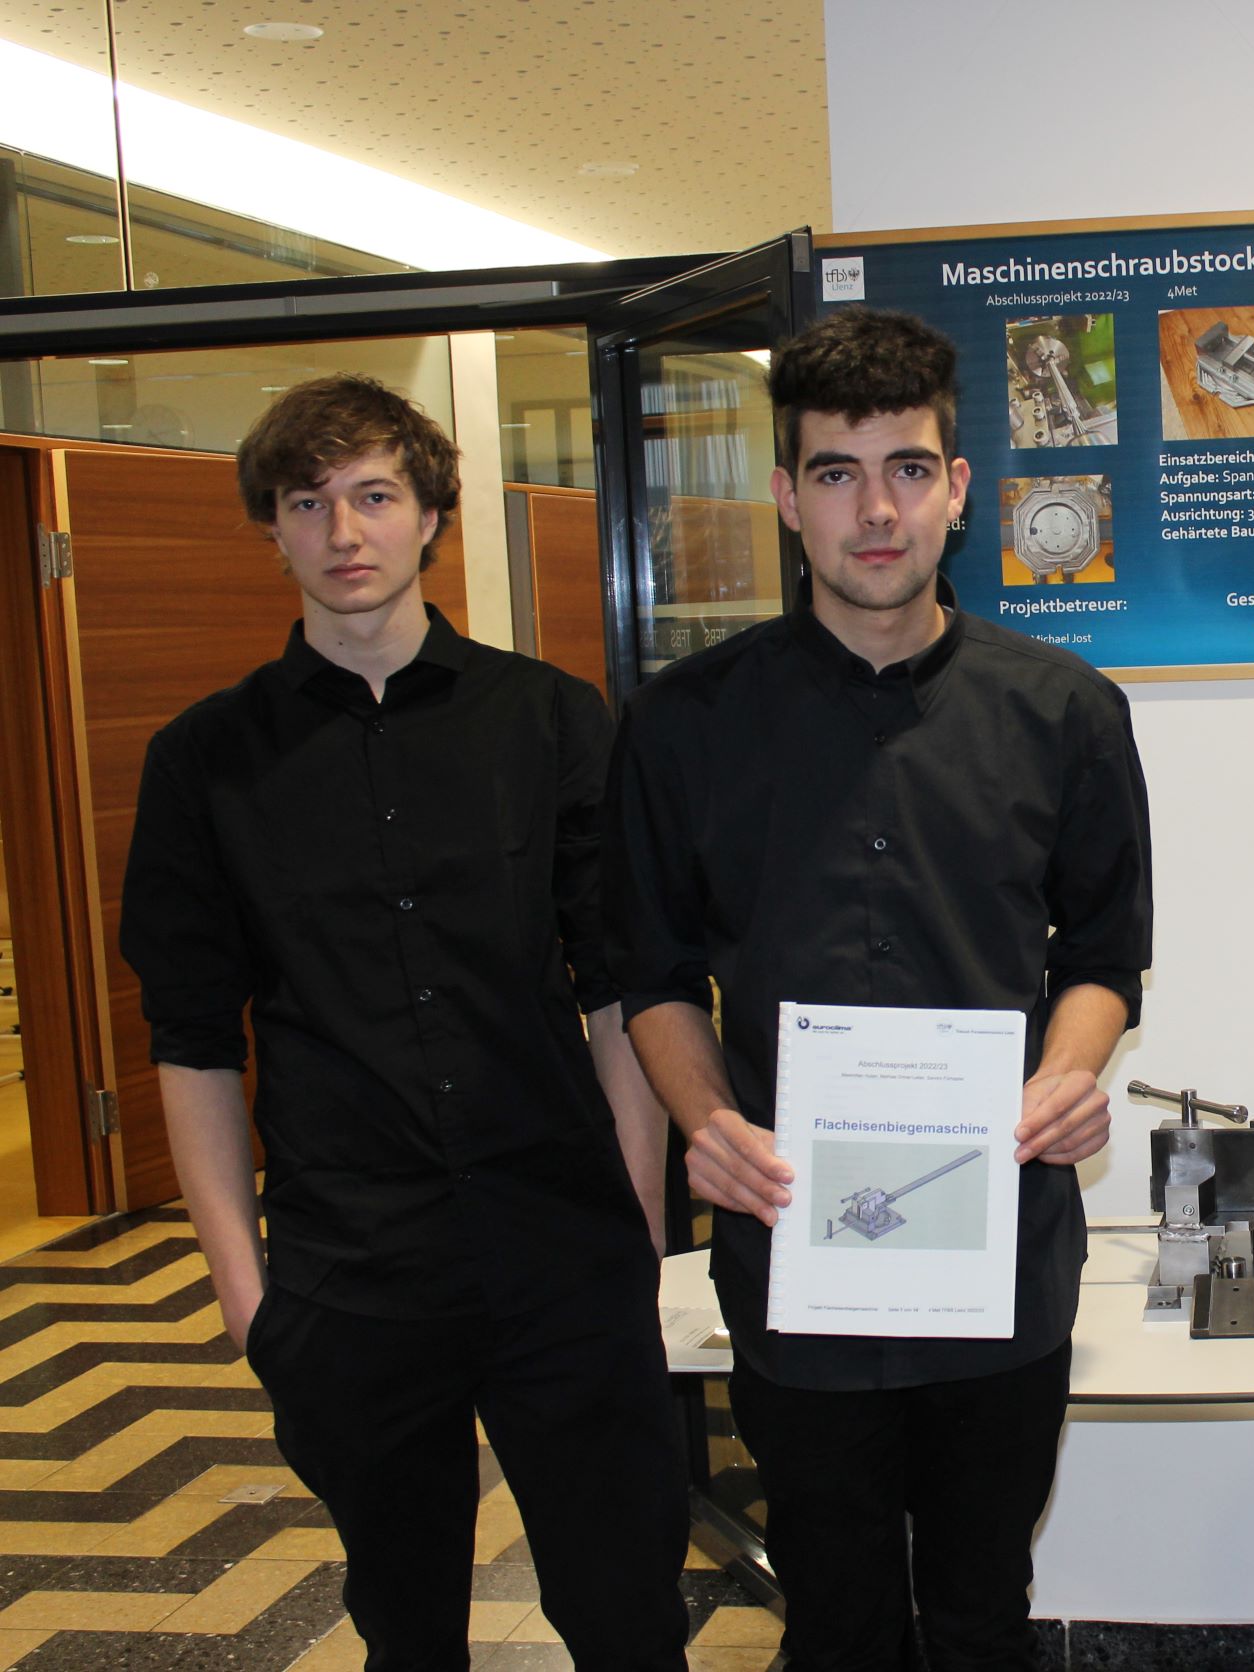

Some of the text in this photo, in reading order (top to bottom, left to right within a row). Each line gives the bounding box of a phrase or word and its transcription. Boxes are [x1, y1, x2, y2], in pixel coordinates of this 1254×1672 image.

[986, 288, 1130, 307] Abschlussprojekt 2022/23
[1167, 285, 1198, 300] 4Met
[1159, 472, 1219, 487] Aufgabe:
[1161, 507, 1245, 523] Ausrichtung:
[1161, 527, 1228, 541] Gehärtete
[1000, 599, 1128, 618] Projektbetreuer:
[1072, 633, 1093, 644] Jost
[858, 1060, 949, 1071] Abschlussprojekt 2022/23
[814, 1118, 989, 1136] Flacheisenbiegemaschine
